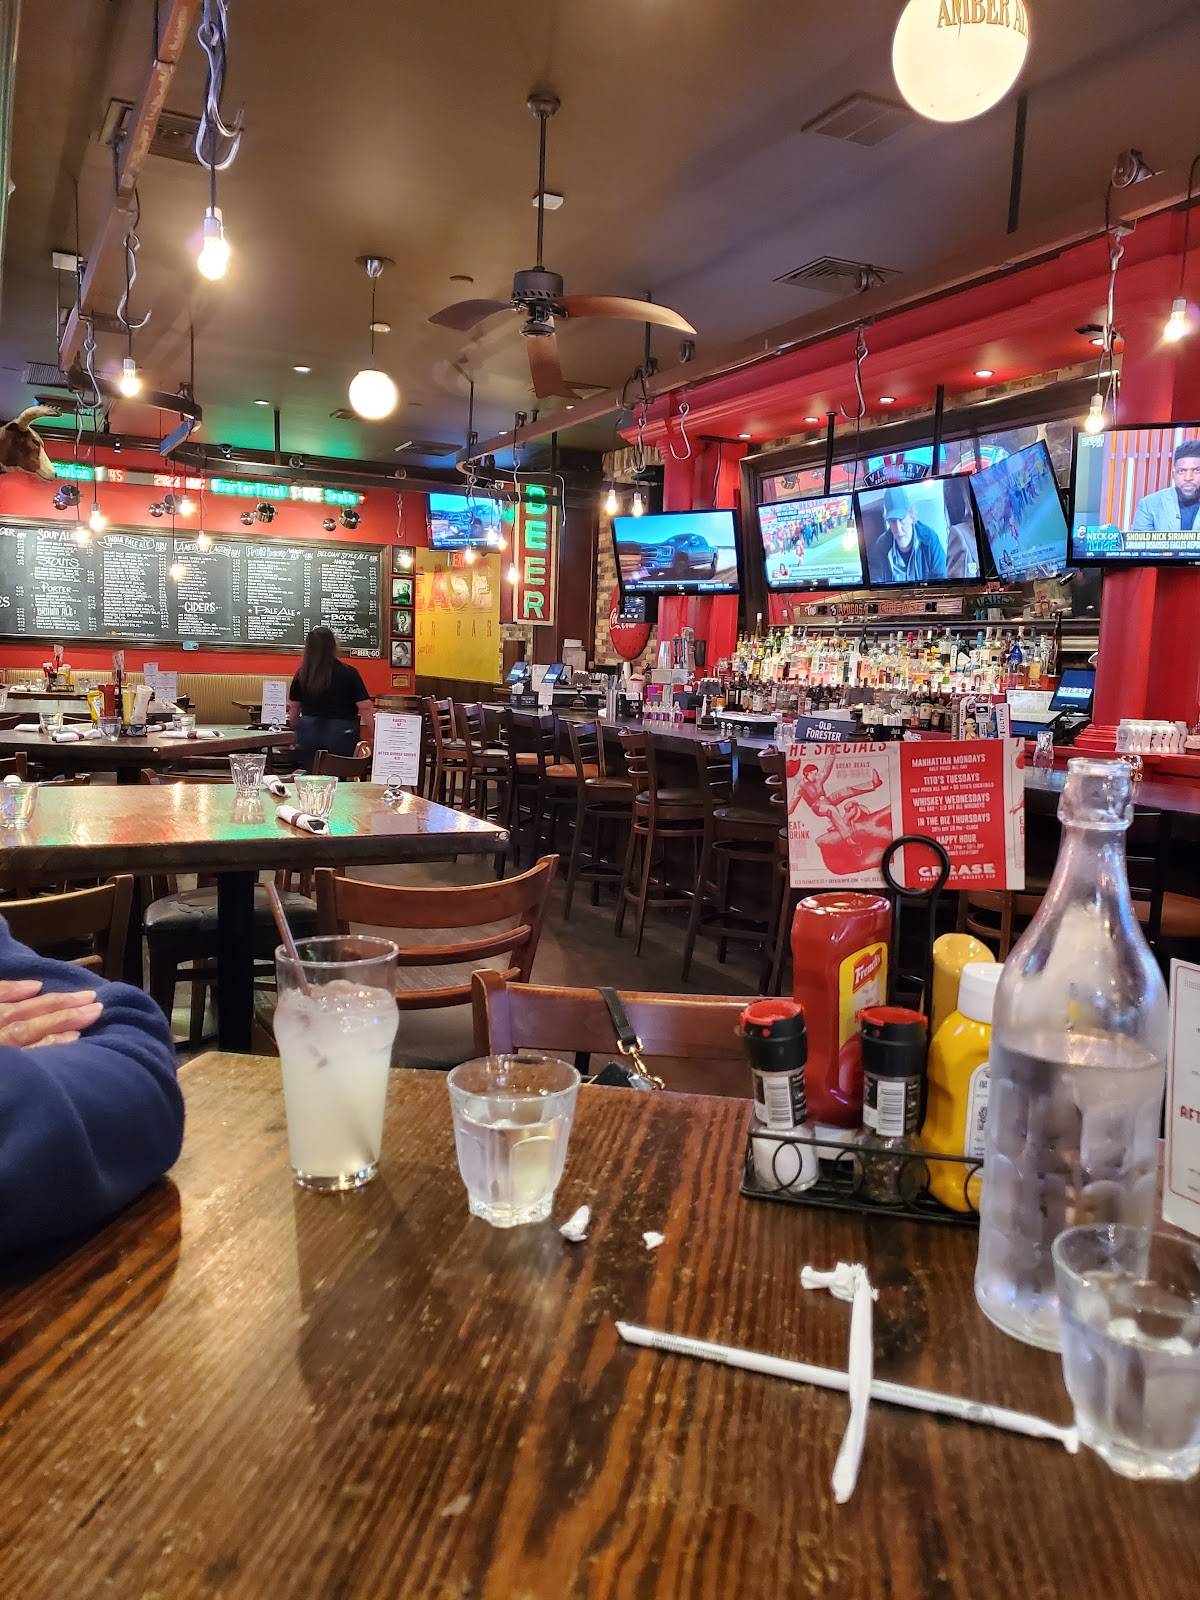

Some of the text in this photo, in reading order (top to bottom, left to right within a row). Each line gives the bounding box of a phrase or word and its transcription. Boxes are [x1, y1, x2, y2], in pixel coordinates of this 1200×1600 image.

[937, 0, 1010, 28] AMBER
[1126, 533, 1151, 541] SHOULD
[1151, 533, 1167, 541] NICK
[341, 552, 358, 560] STYLE
[524, 485, 548, 618] BEER
[36, 555, 80, 568] STOUTS
[39, 581, 72, 594] PORTER
[184, 601, 216, 612] CIDERS
[254, 605, 296, 617] PALE ALE
[331, 613, 355, 621] BOCK
[818, 720, 832, 731] OLD
[806, 727, 842, 741] FORESTER
[912, 753, 986, 767] MANHATTAN MONDAYS
[923, 773, 980, 785] TITO'S TUESDAYS
[912, 793, 990, 807] WHISKEY WEDNESDAYS
[917, 813, 991, 826] IN THE BIZ THURSDAYS
[789, 830, 810, 839] DRINK
[936, 833, 976, 845] HAPPY HOUR
